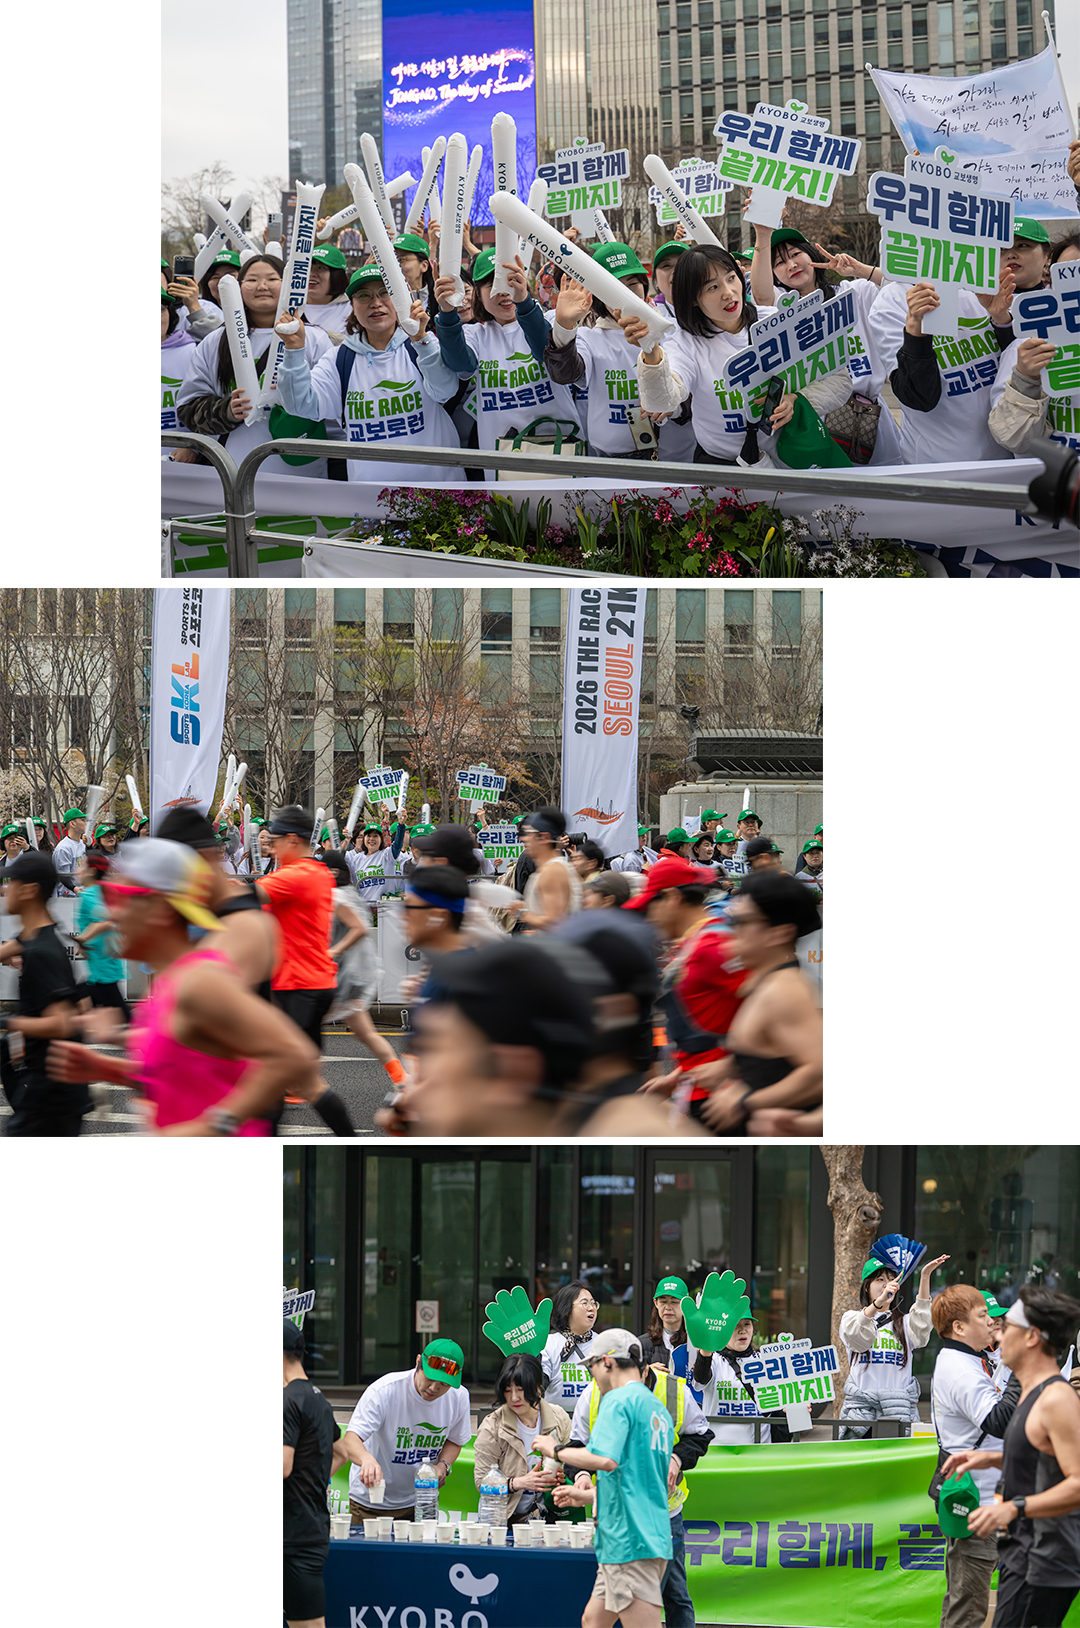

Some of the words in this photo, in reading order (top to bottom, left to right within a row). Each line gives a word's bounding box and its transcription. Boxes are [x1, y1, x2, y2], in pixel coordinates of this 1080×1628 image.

[479, 78, 493, 99] of
[759, 106, 798, 121] KYOBO
[800, 116, 825, 128] 교보생명
[557, 148, 584, 159] KYOBO
[718, 114, 785, 154] 우리
[787, 129, 857, 171] 함께
[374, 163, 384, 188] KYOBO
[498, 162, 507, 191] KYOB
[537, 161, 579, 188] 우리
[583, 151, 627, 182] 함께
[720, 147, 834, 202] 끝까지!
[911, 160, 951, 179] KYOBO
[954, 172, 979, 185] 교보생명
[457, 176, 465, 211] KYOBO
[547, 181, 619, 215] 끝까지!
[665, 187, 685, 214] KYOBO
[341, 206, 359, 219] KYOB
[873, 176, 940, 230] 우리
[948, 190, 1011, 242] 함께
[225, 219, 242, 239] KYOBO
[296, 205, 317, 254] 끝까지!
[527, 233, 563, 265] KYOBO
[562, 263, 586, 284] 교보생명
[886, 230, 997, 289] 끝까지!
[290, 257, 311, 290] 함께,
[379, 266, 394, 296] KYOBO
[1058, 267, 1080, 280] KY
[234, 310, 246, 339] KYOBO
[755, 307, 795, 337] KYOBO
[796, 295, 820, 313] 교보생명
[728, 330, 791, 388] 우리
[794, 292, 855, 352] 함께
[479, 360, 499, 370] 2026
[479, 369, 508, 388] THE
[510, 361, 548, 389] RACE
[604, 370, 627, 380] 2026
[481, 381, 555, 412] 교보로런
[605, 379, 639, 400] THE
[347, 400, 375, 419] THE
[379, 391, 423, 417] RACE
[349, 411, 424, 442] 교보로런
[181, 602, 189, 645] SPORTS
[577, 636, 599, 675] THE
[171, 653, 200, 746] SKL
[603, 643, 634, 736] SEOUL
[575, 680, 598, 735] 2026
[360, 776, 382, 789] 우리
[457, 772, 479, 786] 우리
[482, 776, 504, 790] 함께
[460, 785, 498, 803] 끝까지!
[478, 832, 502, 844] 우리
[724, 860, 745, 874] 우리
[504, 1328, 520, 1341] 우리
[519, 1318, 535, 1333] 함께
[705, 1316, 727, 1327] KYOBO
[510, 1329, 537, 1348] 끝까지!
[763, 1344, 791, 1354] KYOBO
[561, 1369, 583, 1382] THE
[743, 1356, 788, 1383] 우리
[791, 1348, 837, 1377] 함께
[717, 1387, 738, 1400] THE
[757, 1375, 833, 1410] 끝까지!
[415, 1434, 446, 1448] RACE
[683, 1520, 770, 1568] 우리
[778, 1520, 888, 1571] 함께,
